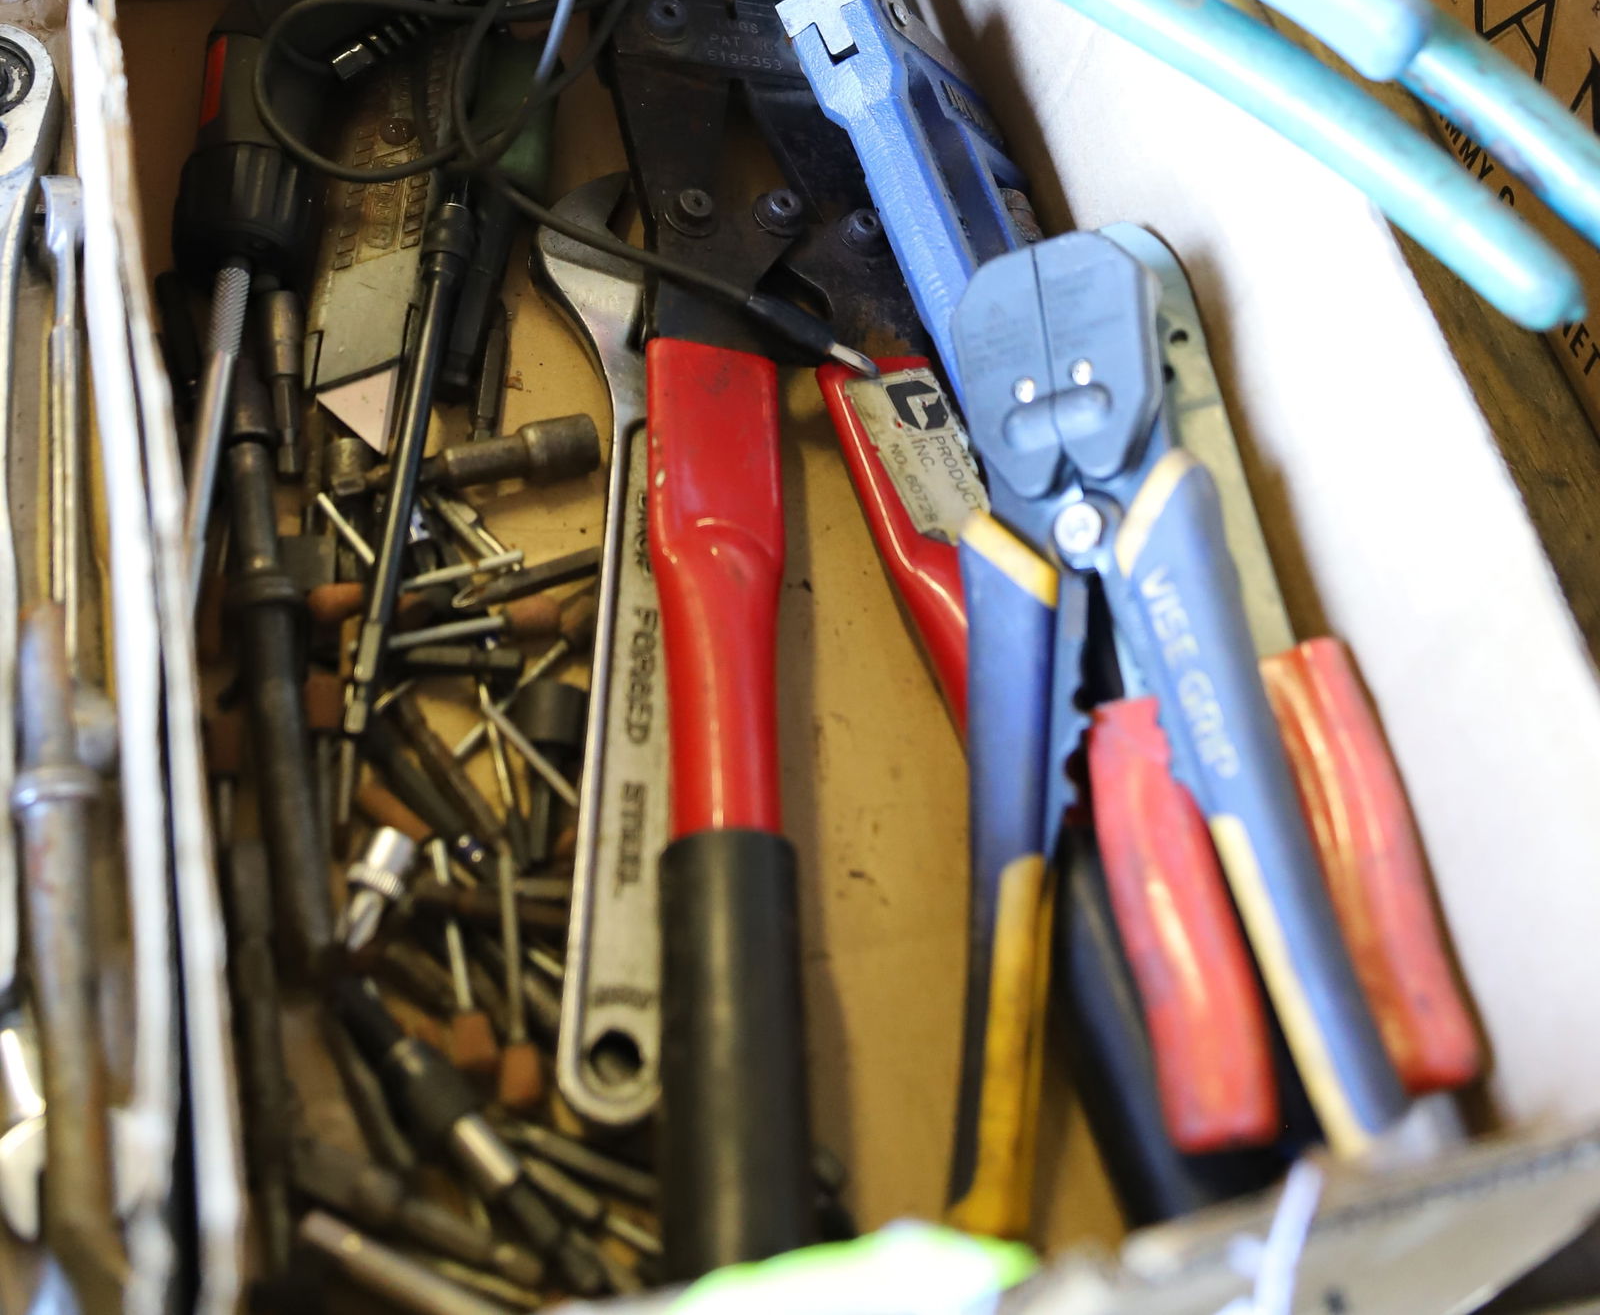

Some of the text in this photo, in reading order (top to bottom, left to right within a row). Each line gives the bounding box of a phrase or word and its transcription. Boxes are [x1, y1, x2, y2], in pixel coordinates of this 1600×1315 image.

[707, 49, 783, 72] 5195353
[911, 436, 937, 474] INC.
[904, 473, 939, 524] 60728
[625, 607, 659, 746] FORGED
[1140, 563, 1240, 779] VISE GRIP
